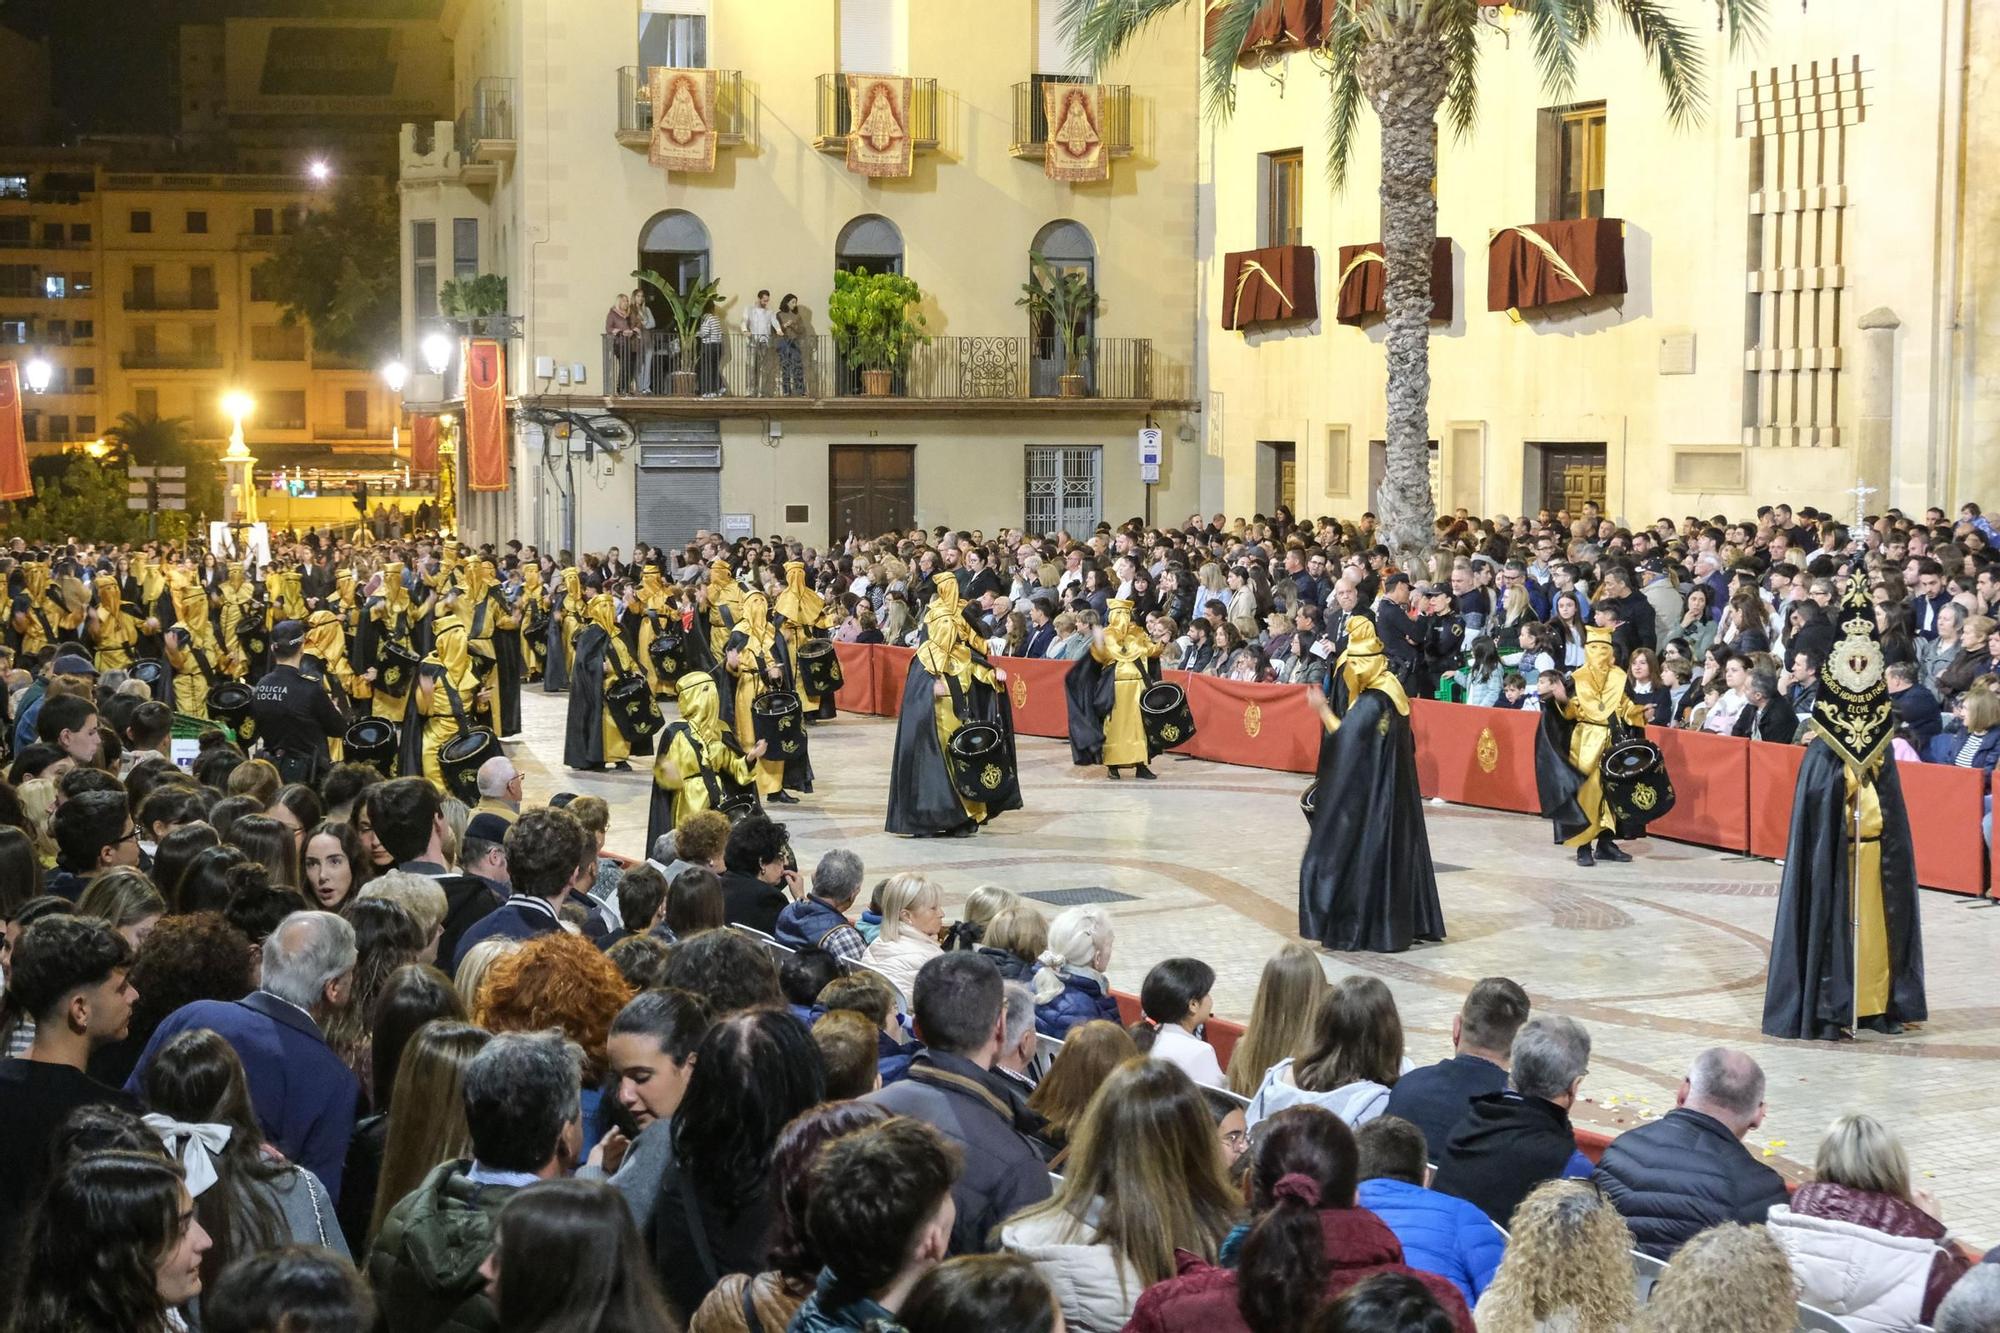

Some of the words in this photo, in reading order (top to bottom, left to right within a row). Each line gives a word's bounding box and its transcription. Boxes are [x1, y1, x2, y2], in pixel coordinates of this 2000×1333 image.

[257, 693, 282, 701] LOCAL
[1857, 694, 1866, 703] DE
[1847, 704, 1869, 713] ELCHE
